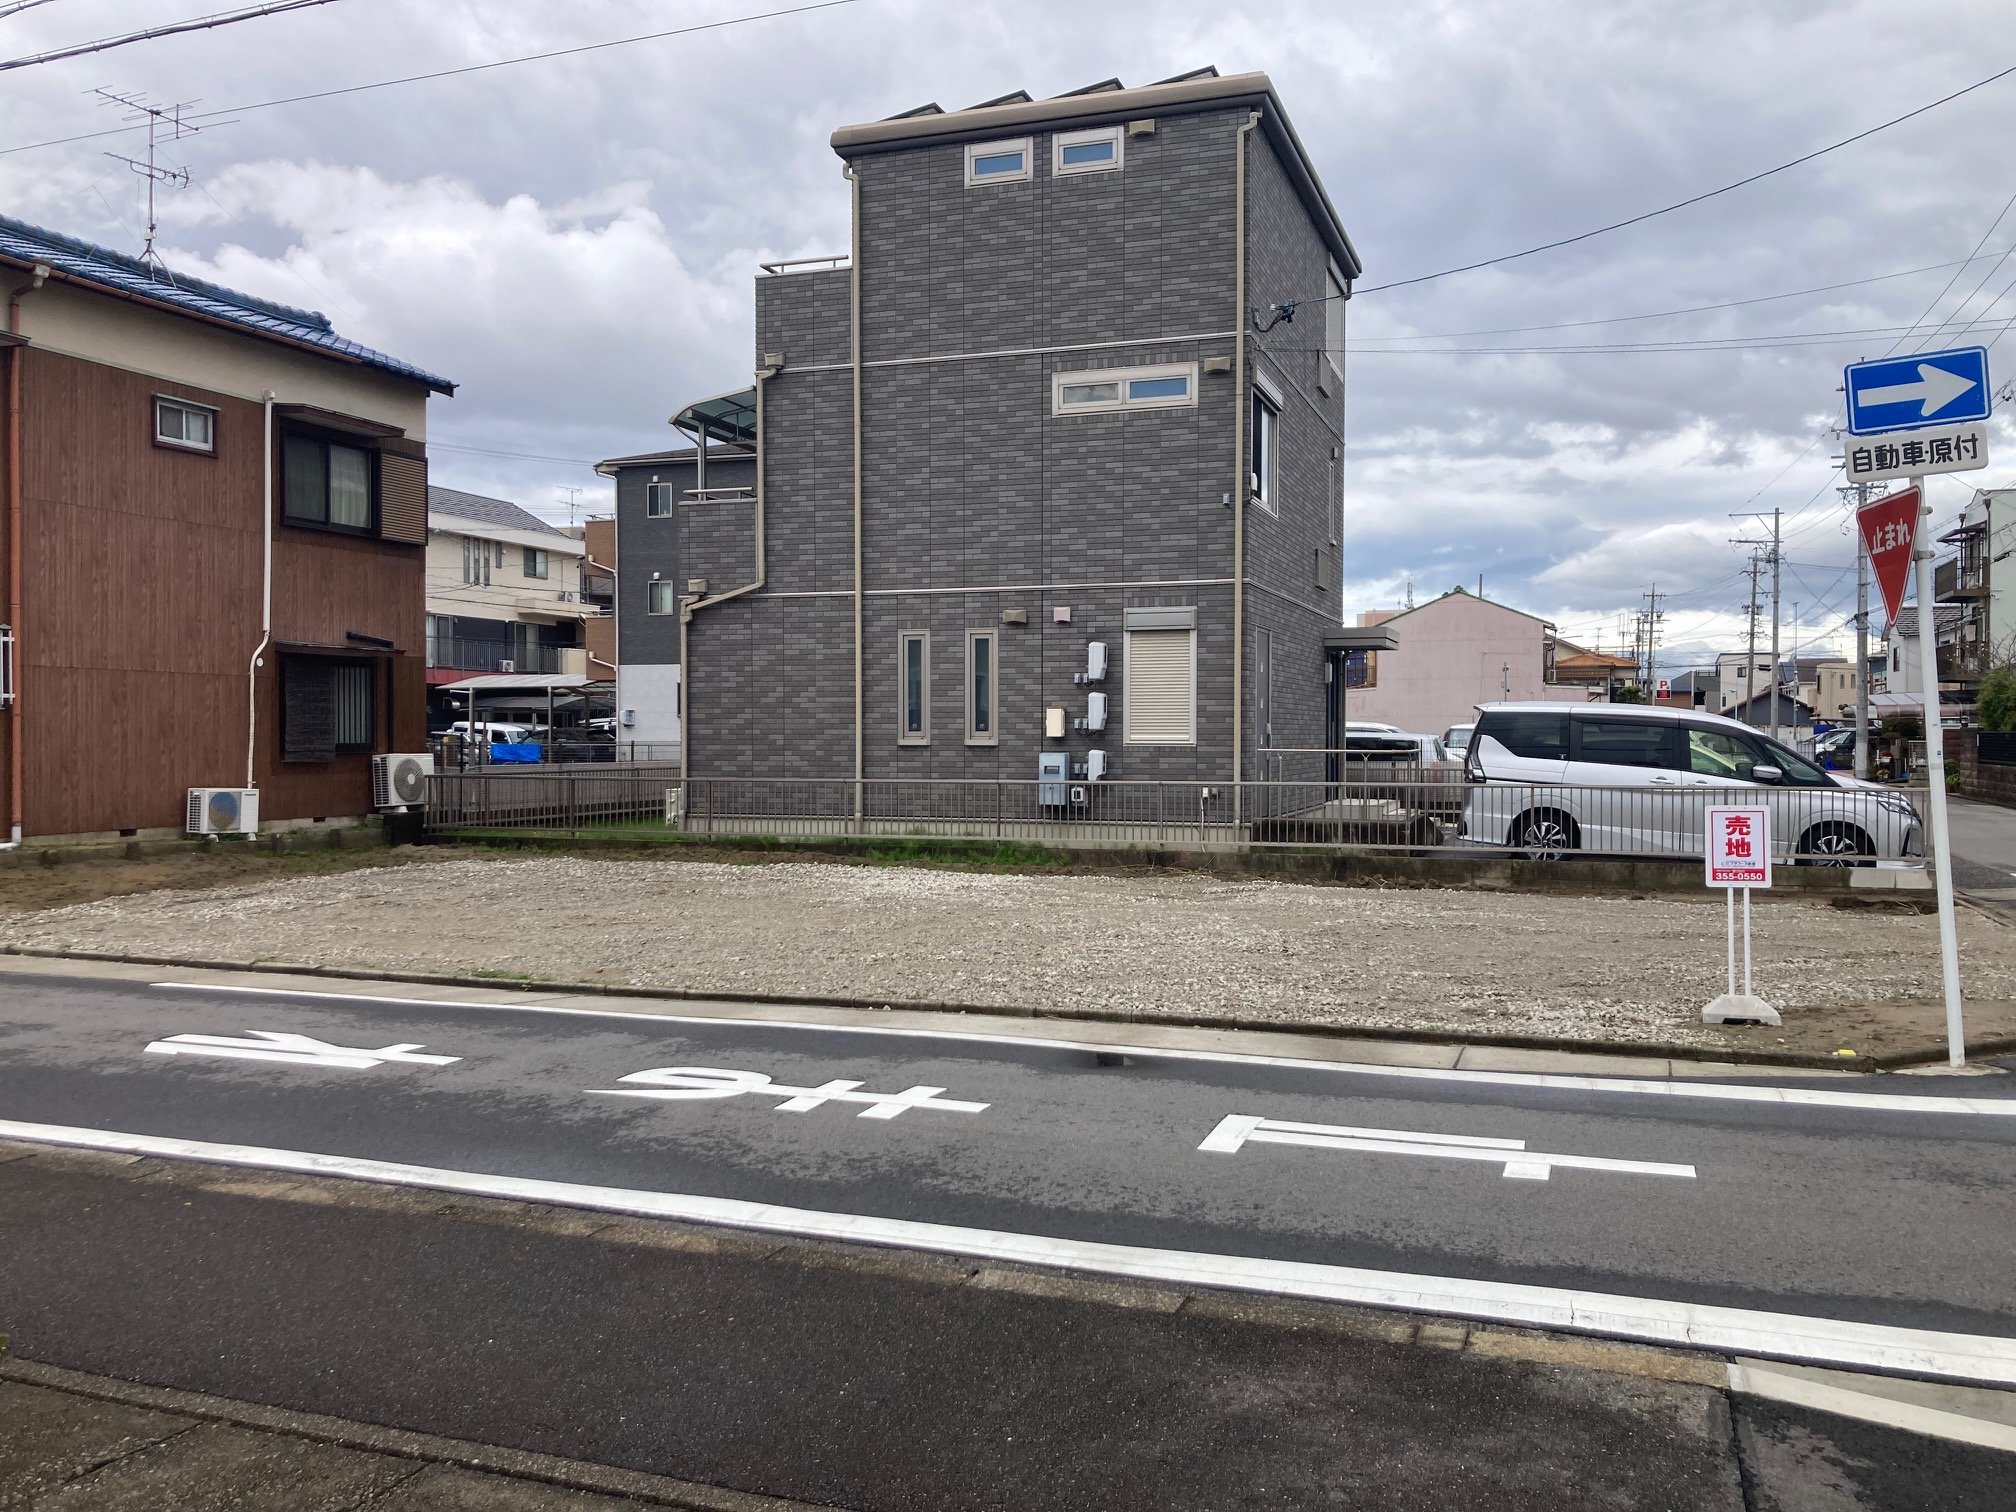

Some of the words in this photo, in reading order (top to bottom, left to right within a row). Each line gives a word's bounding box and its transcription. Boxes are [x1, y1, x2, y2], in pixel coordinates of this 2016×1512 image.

[1872, 518, 1911, 555] 止まれ
[1660, 680, 1668, 689] P
[1725, 815, 1752, 858] 売地
[1715, 872, 1763, 880] 355-0550
